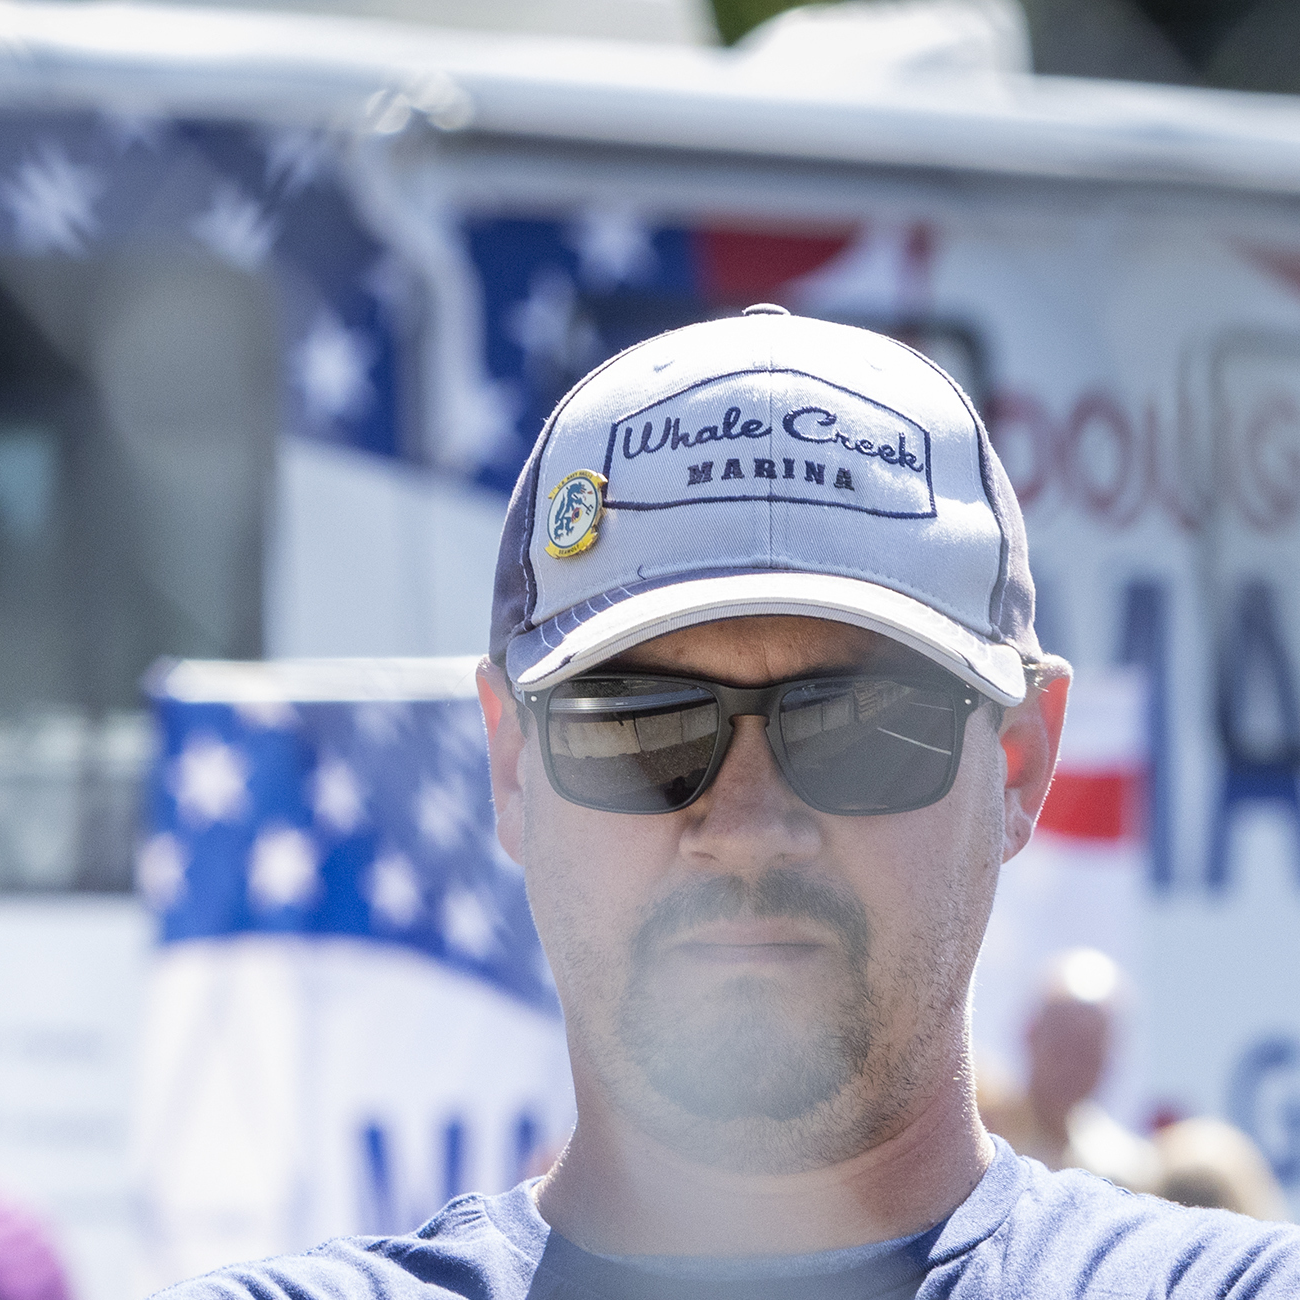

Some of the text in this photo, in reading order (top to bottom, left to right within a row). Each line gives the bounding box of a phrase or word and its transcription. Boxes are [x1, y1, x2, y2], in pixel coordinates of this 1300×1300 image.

[622, 405, 925, 473] Whale Creek
[687, 458, 855, 492] MARINA
